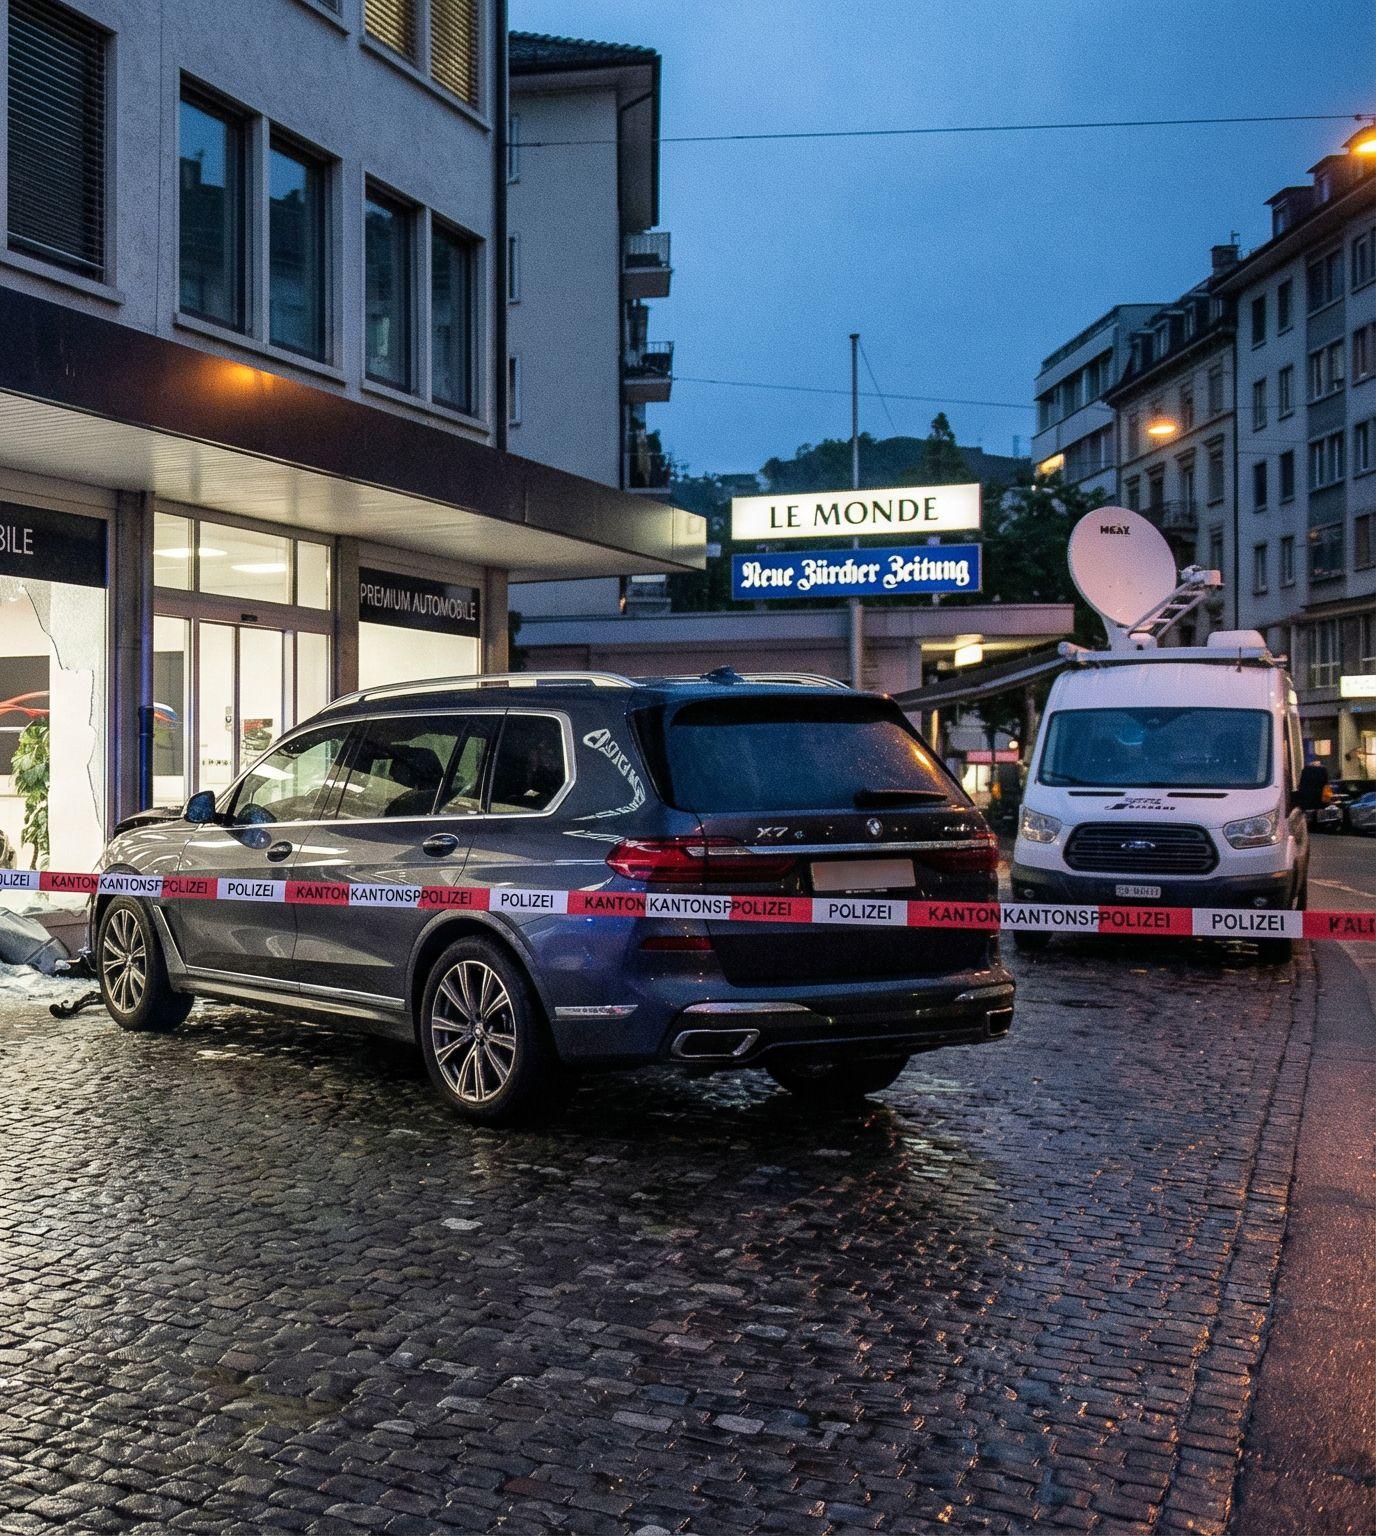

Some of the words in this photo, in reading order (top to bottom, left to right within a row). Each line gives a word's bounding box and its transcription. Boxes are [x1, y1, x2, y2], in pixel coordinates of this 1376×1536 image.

[770, 505, 800, 528] LE
[814, 497, 940, 526] MONDE
[741, 561, 794, 589] Neue
[796, 558, 881, 591] Zürcher
[883, 555, 971, 589] Zeitung
[360, 583, 411, 612] PREMIUM
[757, 826, 789, 838] X7
[228, 882, 274, 898] POLIZEI
[501, 893, 554, 909] POLIZEI
[829, 904, 892, 920] POLIZEI
[1212, 914, 1285, 932] POLIZEI
